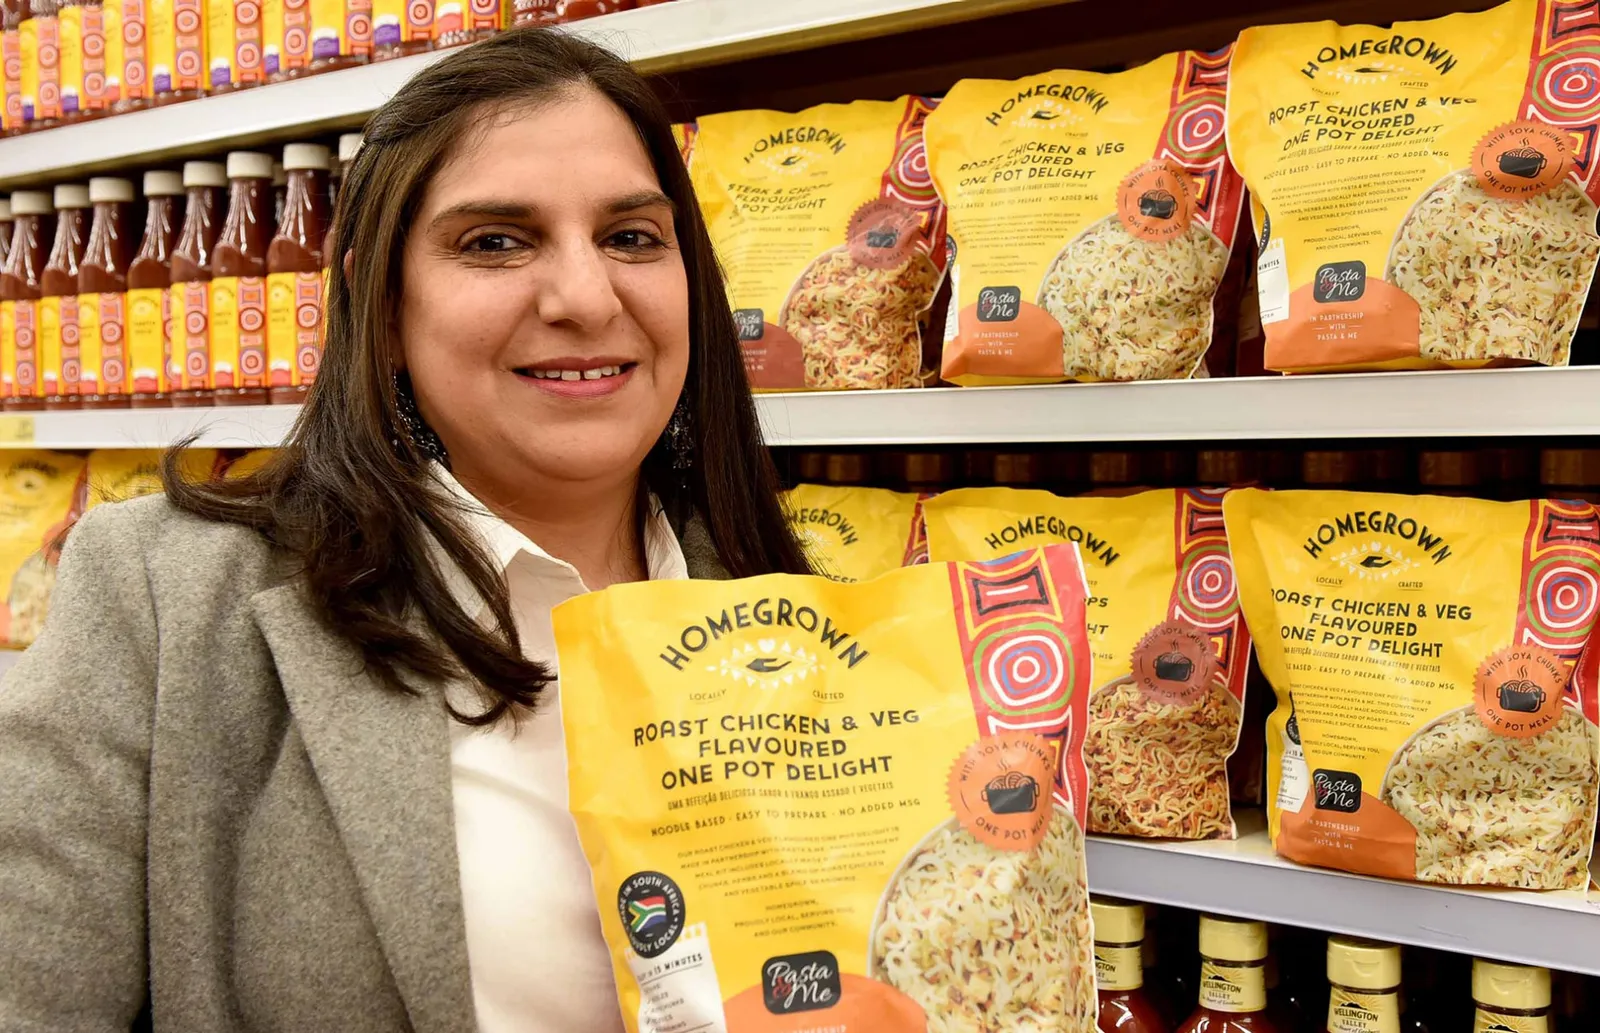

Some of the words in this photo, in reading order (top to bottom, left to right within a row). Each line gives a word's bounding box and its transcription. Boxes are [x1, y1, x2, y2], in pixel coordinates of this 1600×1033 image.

[1301, 35, 1458, 79] HOMEGROWN
[986, 84, 1109, 126] HOMEGROWN
[1269, 101, 1320, 125] ROAST
[1327, 99, 1408, 116] CHICKEN
[1416, 98, 1427, 107] &
[1305, 114, 1414, 129] FLAVOURED
[1284, 130, 1310, 151] ONE
[1316, 129, 1355, 141] POT
[1363, 125, 1444, 141] DELIGHT
[1486, 133, 1505, 147] WITH
[1540, 130, 1565, 152] CHUNKS
[1007, 142, 1071, 159] CHICKEN
[1077, 147, 1086, 155] &
[1096, 143, 1124, 156] VEG
[1290, 165, 1309, 174] BASED
[1317, 161, 1332, 169] EASY
[1347, 155, 1378, 163] PREPARE
[993, 171, 1022, 183] POT
[1028, 168, 1096, 179] DELIGHT
[1128, 172, 1144, 188] WITH
[1484, 171, 1499, 186] ONE
[1500, 185, 1517, 193] POT
[1521, 182, 1547, 193] MEAL
[1319, 268, 1361, 283] Pasta
[981, 290, 1016, 304] Pasta
[1326, 282, 1359, 299] Me
[986, 304, 1014, 318] Me
[1320, 312, 1364, 320] PARTNERSHIP
[984, 516, 1120, 566] HOMEGROWN
[1303, 511, 1452, 565] HOMEGROWN
[1316, 577, 1343, 585] LOCALLY
[1332, 599, 1409, 617] CHICKEN
[1417, 604, 1427, 617] &
[1436, 605, 1471, 620] VEG
[660, 598, 869, 671] HOMEGROWN
[1310, 613, 1417, 636] FLAVOURED
[1281, 626, 1316, 641] ONE
[1322, 632, 1361, 648] POT
[1368, 640, 1443, 657] DELIGHT
[1485, 660, 1505, 676] WITH
[1508, 652, 1531, 661] SOYA
[1537, 656, 1562, 683] CHUNKS
[1354, 671, 1385, 680] PREPARE
[1411, 680, 1435, 688] ADDED
[689, 688, 727, 700] LOCALLY
[813, 690, 844, 700] CRAFTED
[634, 718, 708, 746] ROAST
[721, 713, 830, 734] CHICKEN
[842, 716, 858, 731] &
[870, 710, 919, 727] VEG
[1487, 709, 1502, 725] ONE
[1505, 722, 1523, 731] POT
[1530, 715, 1553, 730] MEAL
[700, 737, 846, 758] FLAVOURED
[961, 760, 976, 781] WITH
[1014, 740, 1050, 771] CHUNKS
[662, 764, 713, 789] ONE
[725, 761, 775, 779] POT
[787, 756, 892, 780] DELIGHT
[1314, 773, 1357, 792] Pasta
[668, 800, 683, 810] UMA
[1320, 790, 1354, 807] Me
[651, 822, 690, 836] NOODLE
[696, 816, 725, 829] BASED
[736, 810, 760, 822] EASY
[767, 810, 779, 819] TO
[784, 810, 826, 819] PREPARE
[840, 807, 855, 816] NO
[861, 801, 894, 814] ADDED
[899, 798, 920, 808] MSG
[1316, 821, 1360, 832] PARTNERSHIP
[976, 816, 999, 836] ONE
[1004, 829, 1028, 840] POT
[624, 885, 632, 897] IN
[632, 876, 662, 888] SOUTH
[662, 883, 680, 915] AFRICA
[654, 924, 678, 950] LOCAL
[664, 953, 702, 970] MINUTES
[767, 961, 833, 986] Pasta
[784, 981, 833, 1009] Me
[1203, 981, 1242, 993] WELLINGTON
[1334, 1008, 1379, 1022] WELLINGTON
[1342, 1020, 1367, 1028] VALLEY
